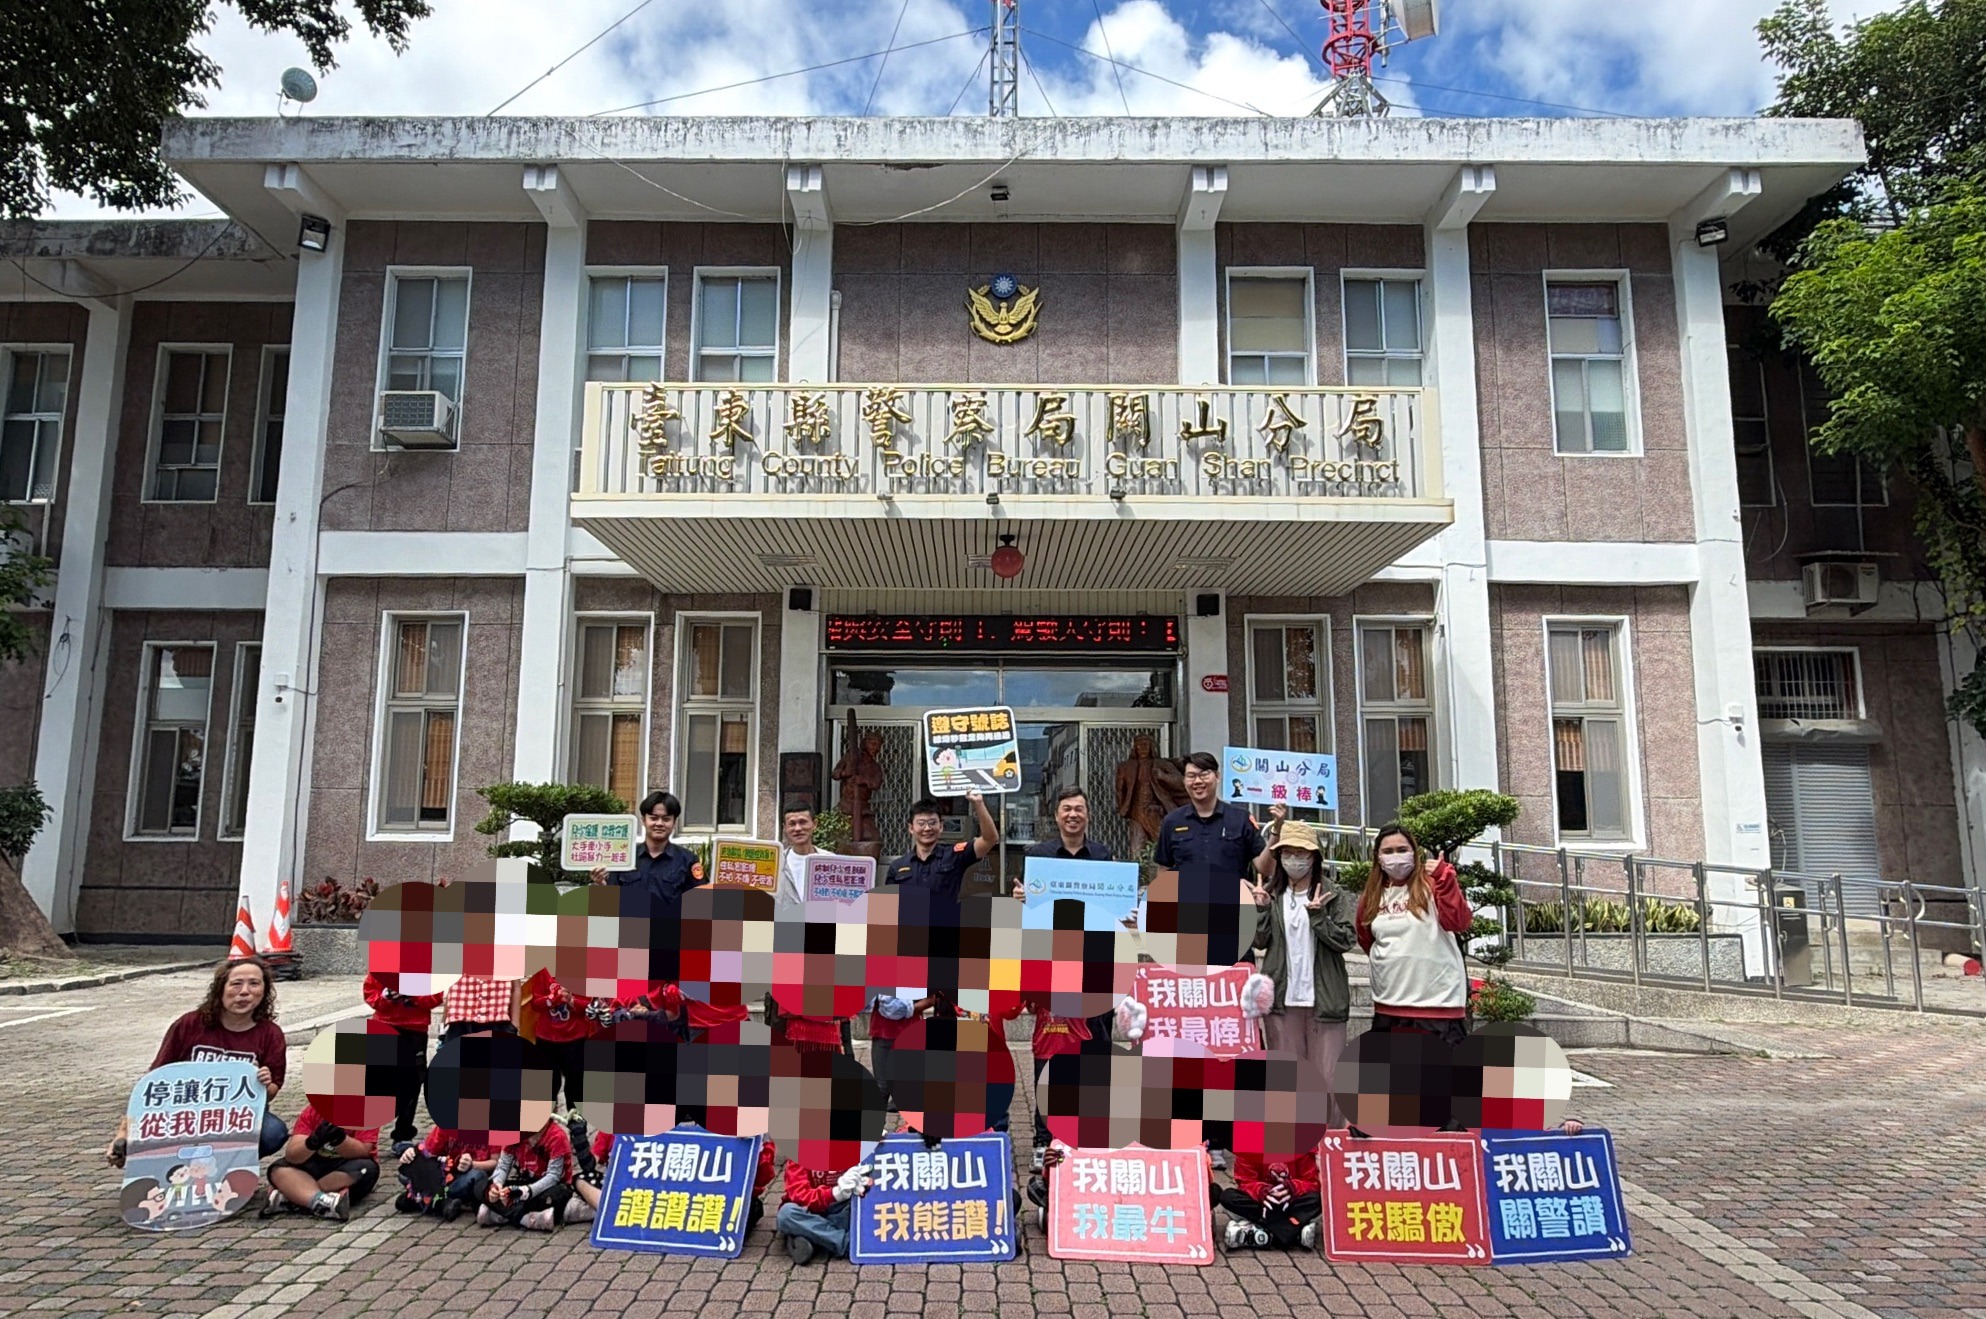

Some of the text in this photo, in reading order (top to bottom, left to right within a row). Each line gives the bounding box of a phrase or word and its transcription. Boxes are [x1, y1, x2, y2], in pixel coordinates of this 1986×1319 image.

[631, 382, 1385, 451] 臺東縣警察局關山分局
[637, 450, 1400, 482] Taitung County Police Bureau Guan Shan Precinct
[1255, 758, 1331, 778] 關山分局
[1247, 784, 1312, 801] 一級棒
[1147, 977, 1239, 1008] 我關山
[143, 1075, 257, 1107] 停讓行人
[139, 1106, 255, 1140] 從我開始
[628, 1141, 732, 1183] 我關山
[873, 1149, 988, 1191] 我關山
[1072, 1149, 1185, 1196] 我關山
[1343, 1150, 1461, 1192] 我關山
[1493, 1150, 1600, 1192] 我關山
[613, 1189, 742, 1235] 讚讚讚!
[873, 1200, 1004, 1243] 我熊讚!
[1072, 1202, 1188, 1243] 我最牛
[1347, 1200, 1467, 1245] 我驕傲
[1499, 1195, 1608, 1239] 關警讚
